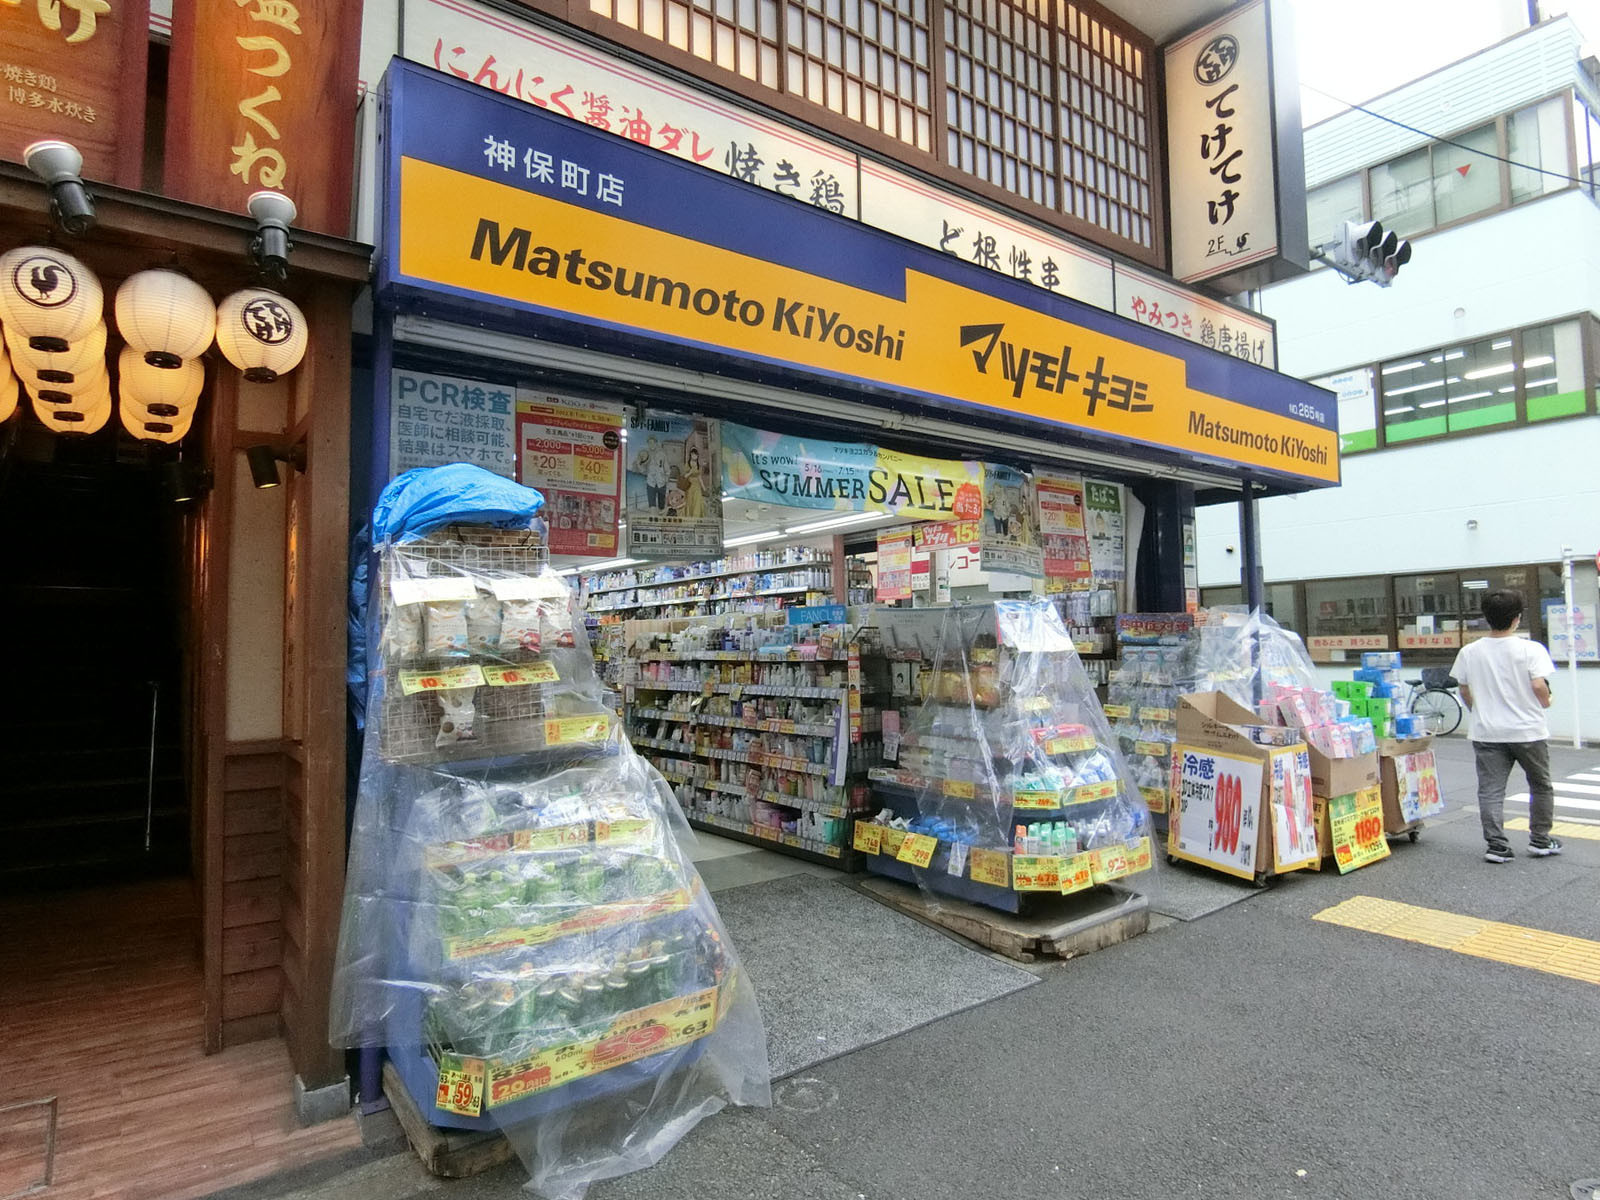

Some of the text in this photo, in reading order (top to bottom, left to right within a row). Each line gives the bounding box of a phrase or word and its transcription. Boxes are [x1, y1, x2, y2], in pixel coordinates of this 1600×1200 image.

[8, 85, 97, 124] 博多水炊き
[433, 37, 845, 217] にんにく醤油ダレ 焼き鶏
[483, 134, 625, 207] 神保町店
[1199, 84, 1243, 226] てけてけ
[939, 218, 1061, 290] ど根性串
[1207, 234, 1225, 254] 2F
[470, 217, 906, 361] Matsumoto KiYoshi
[1130, 296, 1265, 365] やみつき 鶏唐揚げ
[959, 322, 1155, 418] マツモトキヨシ
[398, 376, 512, 416] PCR検査
[397, 404, 511, 433] 自宅でだ液採取、
[397, 420, 511, 449] 医師に相談可能、
[397, 437, 511, 465] 結果はスマホで。
[1187, 410, 1329, 467] Matsumoto KiYoshi
[758, 468, 955, 513] SUMMER SALE
[1090, 484, 1116, 505] たばこ
[801, 606, 832, 623] FANCL
[1350, 638, 1382, 647] 買うとき
[1406, 636, 1454, 646] 便利な店
[1183, 754, 1216, 780] 冷感
[1214, 771, 1243, 857] 980
[1354, 815, 1382, 846] 1180
[454, 1082, 474, 1107] 59
